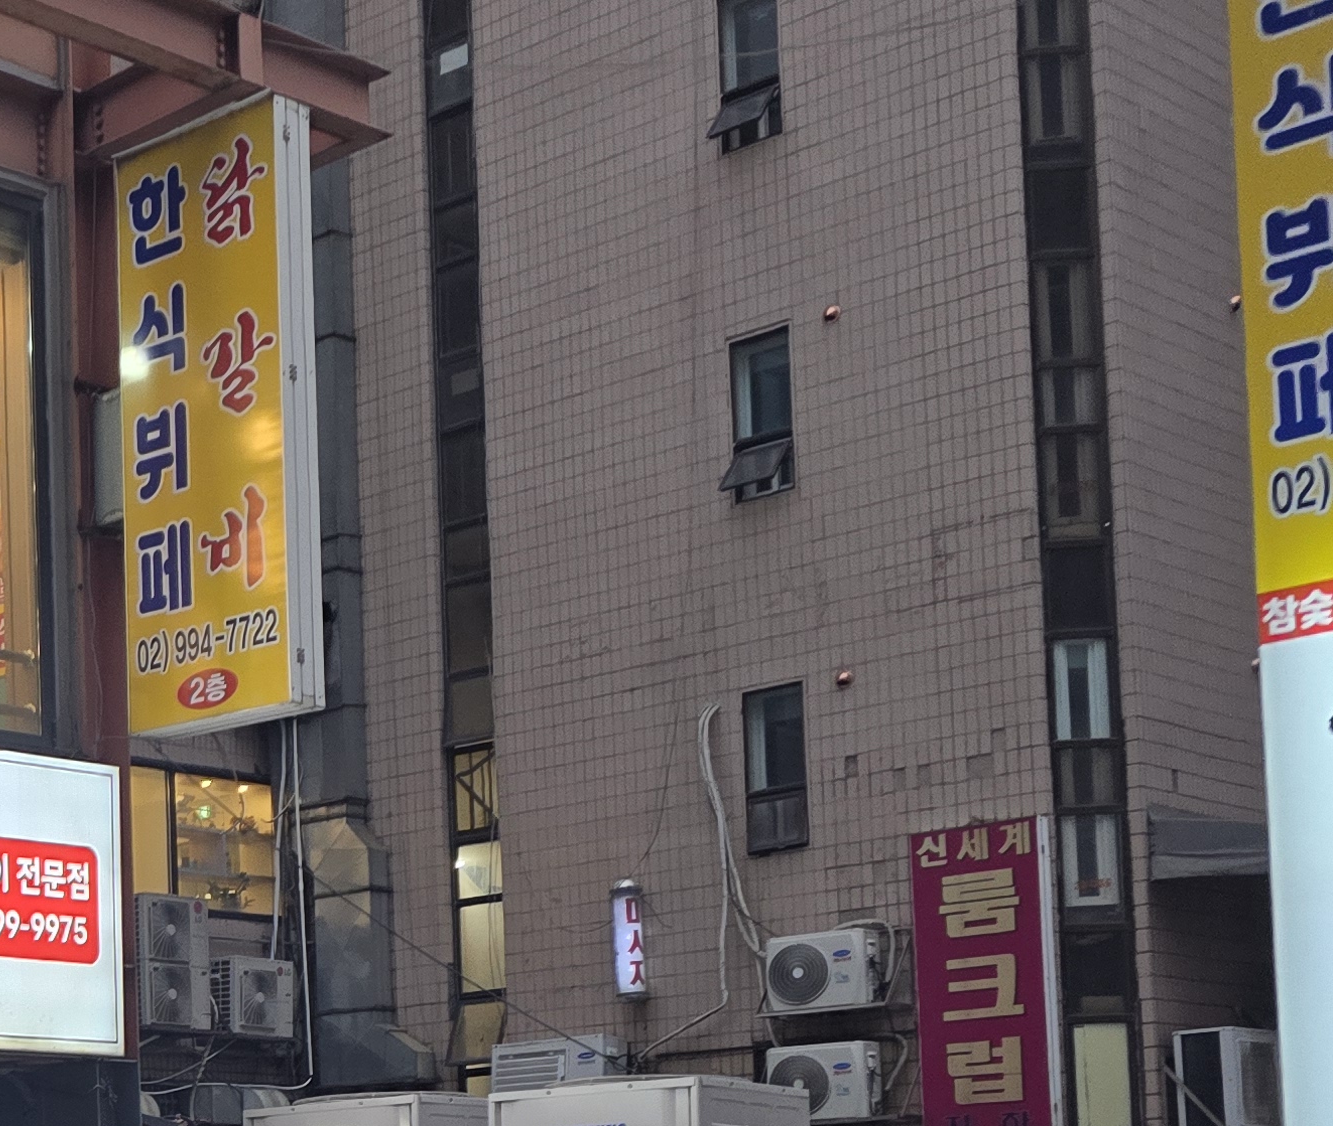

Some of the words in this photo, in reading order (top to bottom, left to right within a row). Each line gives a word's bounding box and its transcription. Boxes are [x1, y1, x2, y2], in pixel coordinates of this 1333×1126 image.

[128, 164, 193, 615] 한식뷔페
[201, 135, 275, 588] 닭갈비
[189, 672, 227, 705] 2층
[16, 856, 90, 900] 전문점
[916, 820, 1032, 868] 신세계
[938, 867, 1025, 1105] 룸크럽
